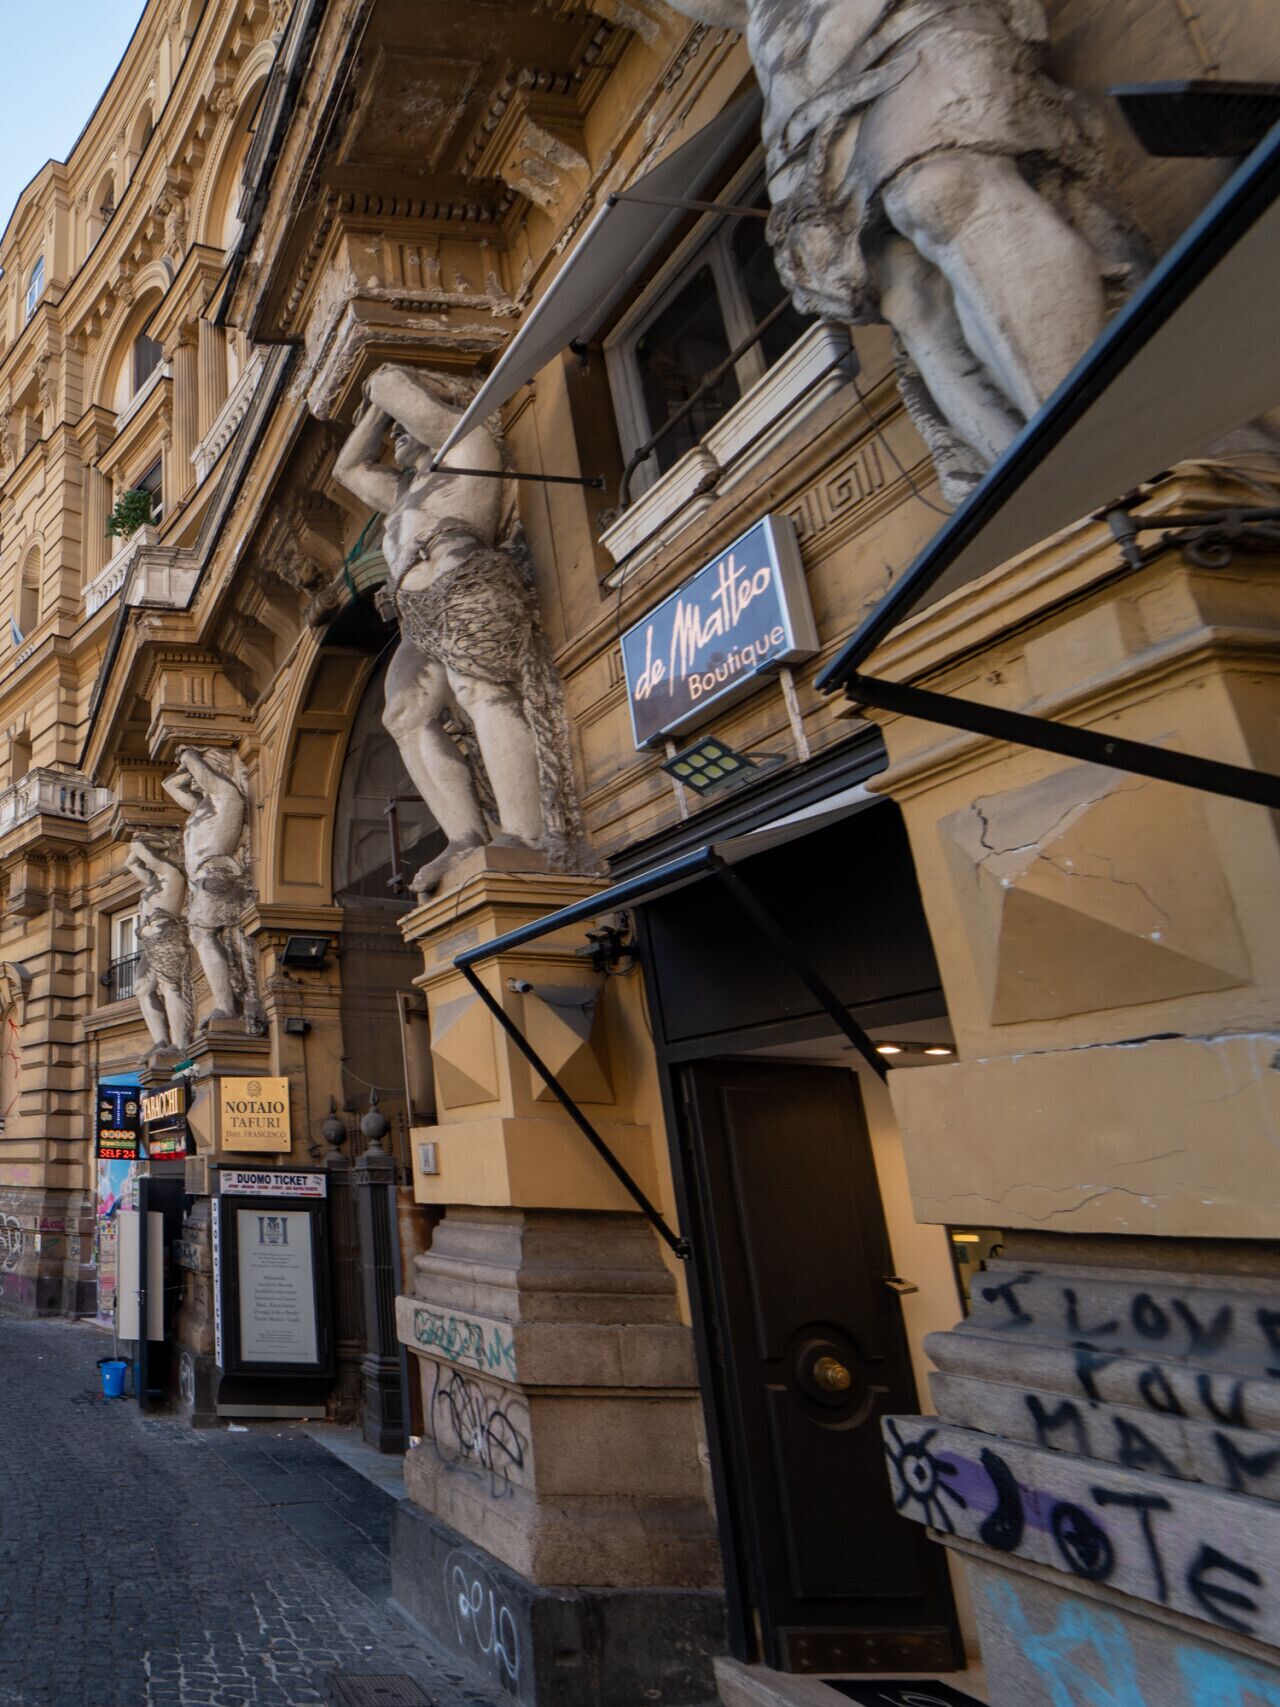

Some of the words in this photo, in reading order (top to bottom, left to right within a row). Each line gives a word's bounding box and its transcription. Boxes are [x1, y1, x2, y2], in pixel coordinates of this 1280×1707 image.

[634, 625, 666, 700] de
[669, 554, 771, 697] Matteo
[688, 626, 785, 700] Boutique
[225, 1101, 284, 1113] NOTAIO
[230, 1117, 280, 1128] TAFURI
[100, 1148, 122, 1158] SELF
[123, 1149, 136, 1159] 24
[237, 1173, 271, 1184] DUOMO
[273, 1175, 308, 1186] TICKET
